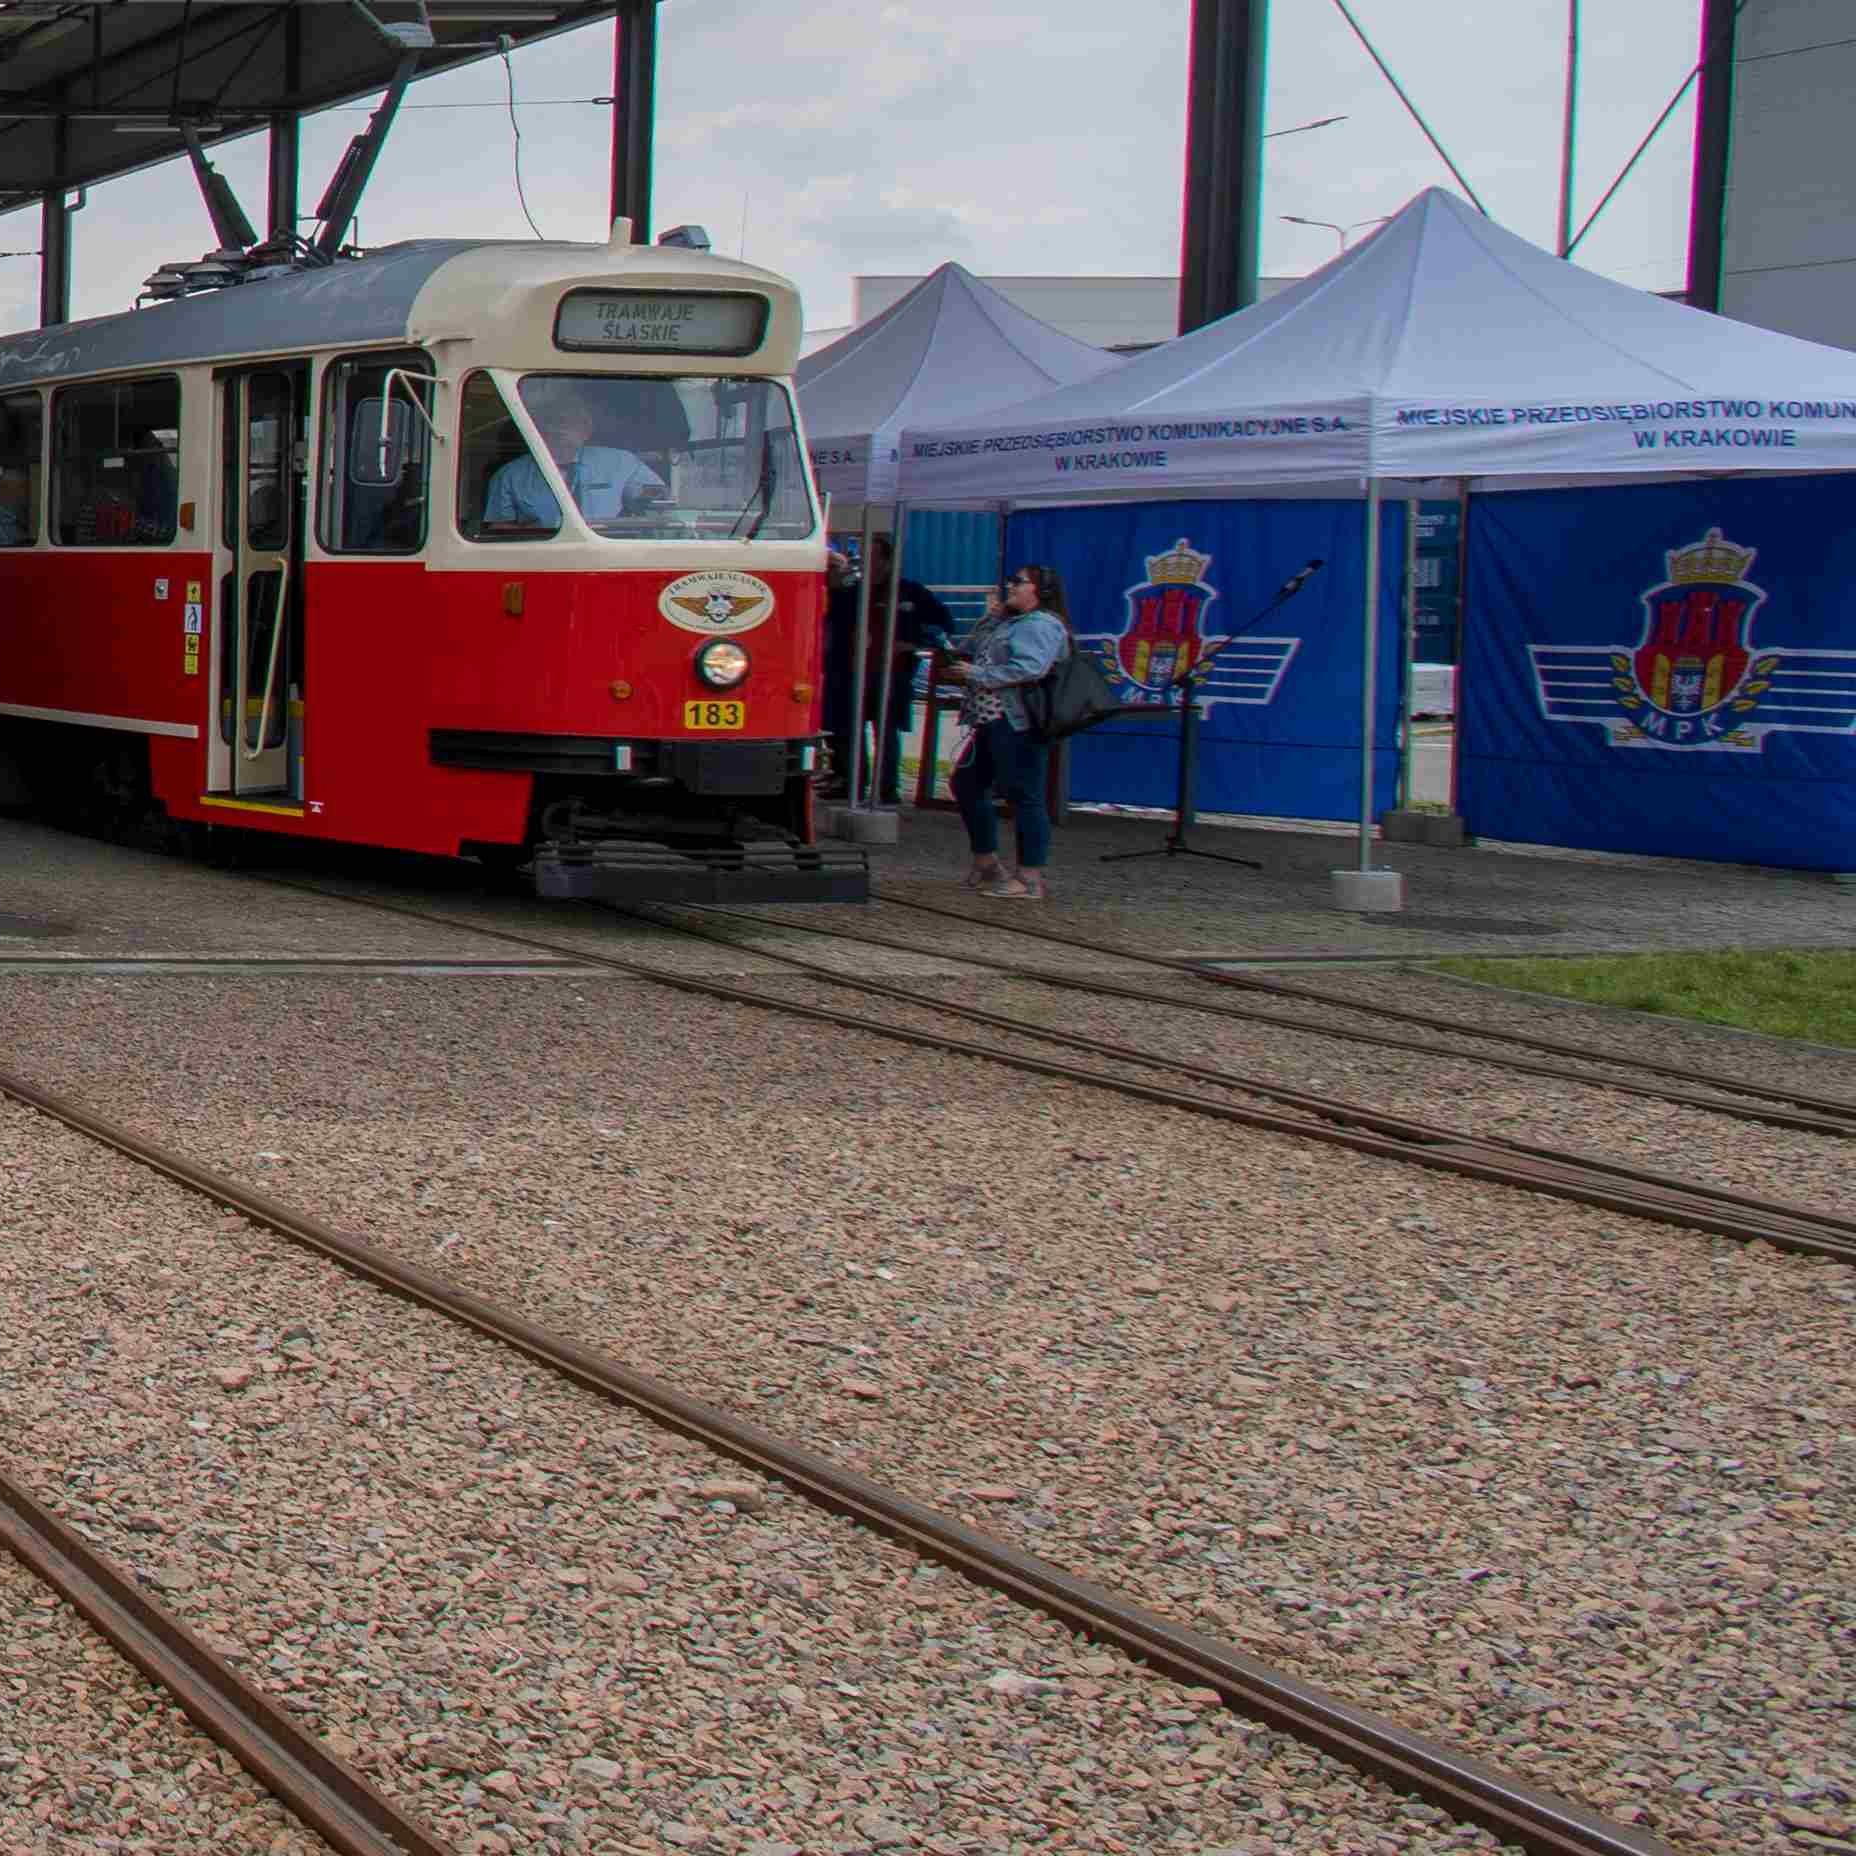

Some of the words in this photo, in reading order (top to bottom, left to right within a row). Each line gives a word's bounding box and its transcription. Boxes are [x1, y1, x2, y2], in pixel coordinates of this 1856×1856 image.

[596, 303, 696, 321] TRAMWAJE
[1396, 408, 1506, 426] MIEJSKIE
[1511, 400, 1762, 425] PRZEDSIĘBIORSTWO
[912, 439, 980, 457] MIEJSKIE
[983, 424, 1147, 453] PRZEDSIĘBIORSTWO
[1148, 417, 1308, 441] KOMUNIKACYJNE
[1633, 430, 1658, 448] W
[1663, 428, 1796, 447] KRAKOWIE
[1054, 455, 1072, 472] W
[1074, 450, 1167, 472] KRAKOWIE
[689, 704, 739, 726] 183
[1639, 711, 1725, 739] MPK
